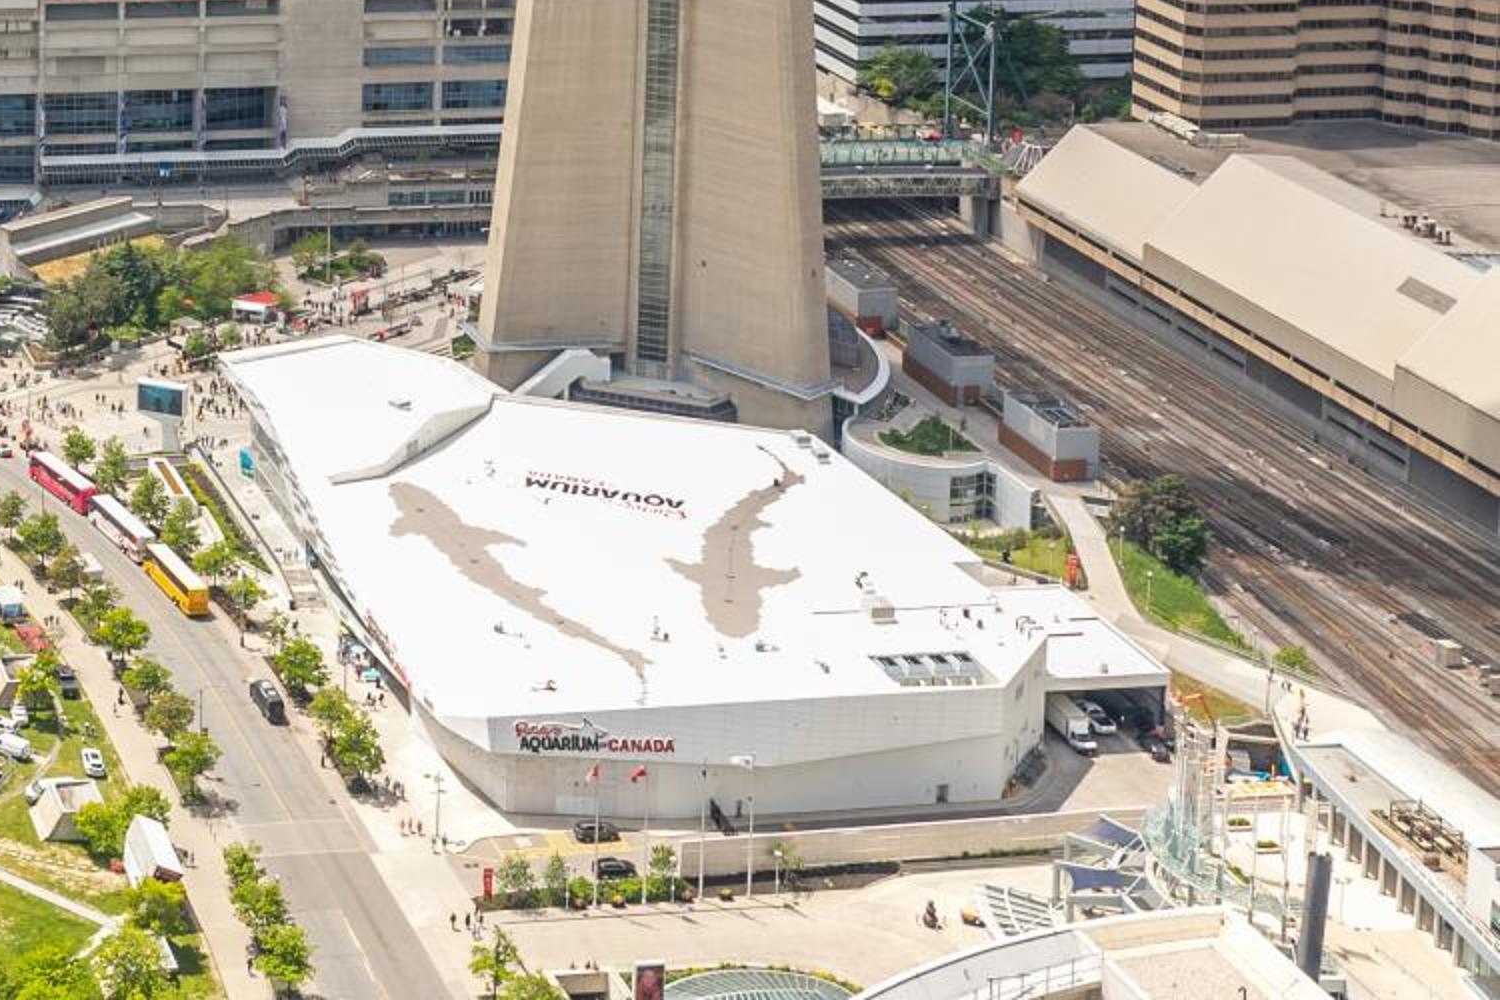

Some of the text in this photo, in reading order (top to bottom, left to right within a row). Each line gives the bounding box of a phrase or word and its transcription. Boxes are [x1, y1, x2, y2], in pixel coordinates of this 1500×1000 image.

[525, 476, 685, 509] AQUARIUM
[520, 734, 599, 753] AQUARIUM
[608, 738, 675, 753] CANADA
